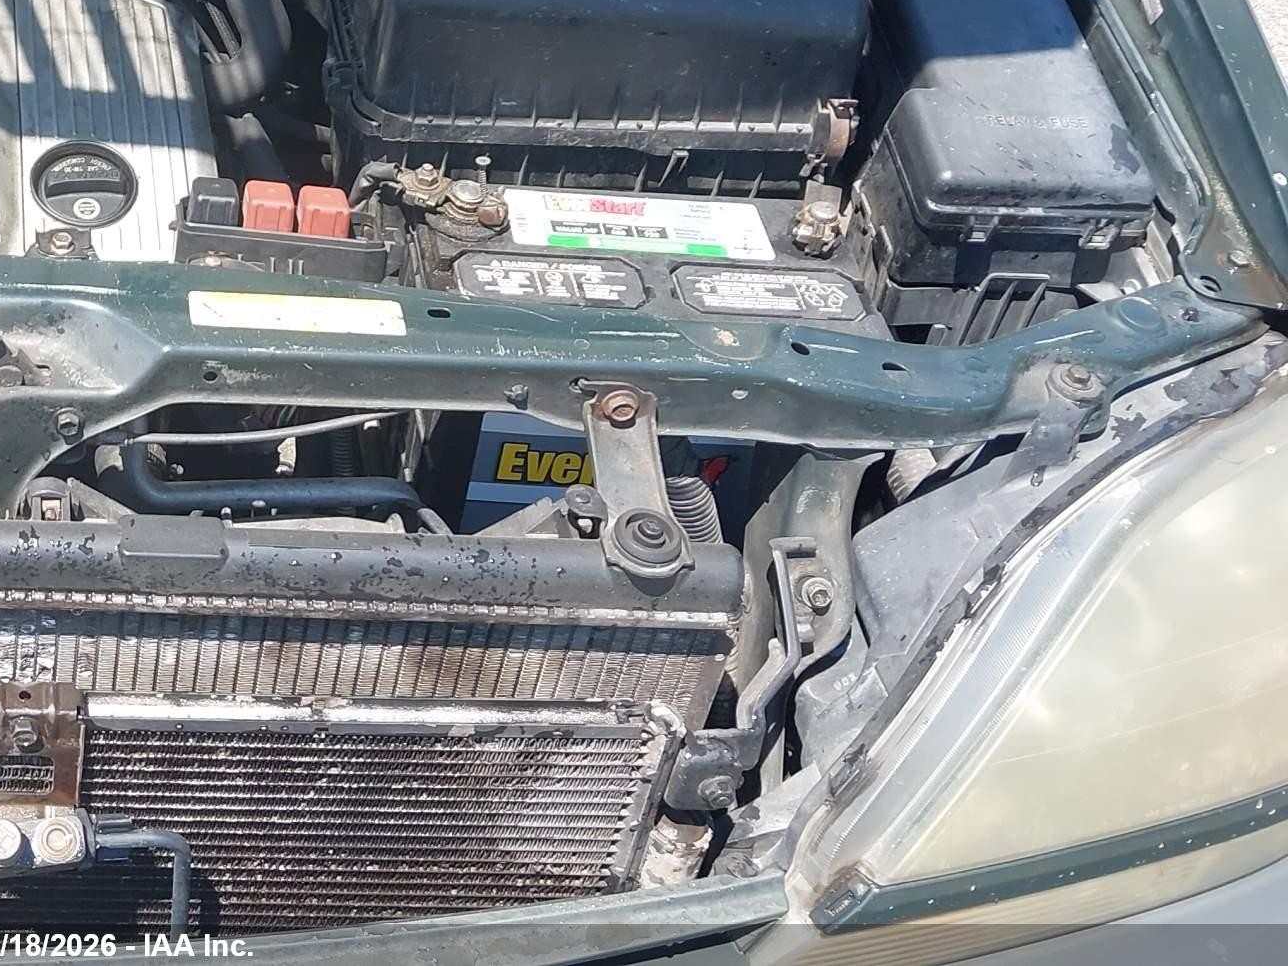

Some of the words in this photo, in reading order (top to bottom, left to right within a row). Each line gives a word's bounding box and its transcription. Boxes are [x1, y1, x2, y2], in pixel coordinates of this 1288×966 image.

[985, 114, 1029, 129] RELAY
[1033, 115, 1048, 130] &
[1049, 115, 1089, 130] FUSE
